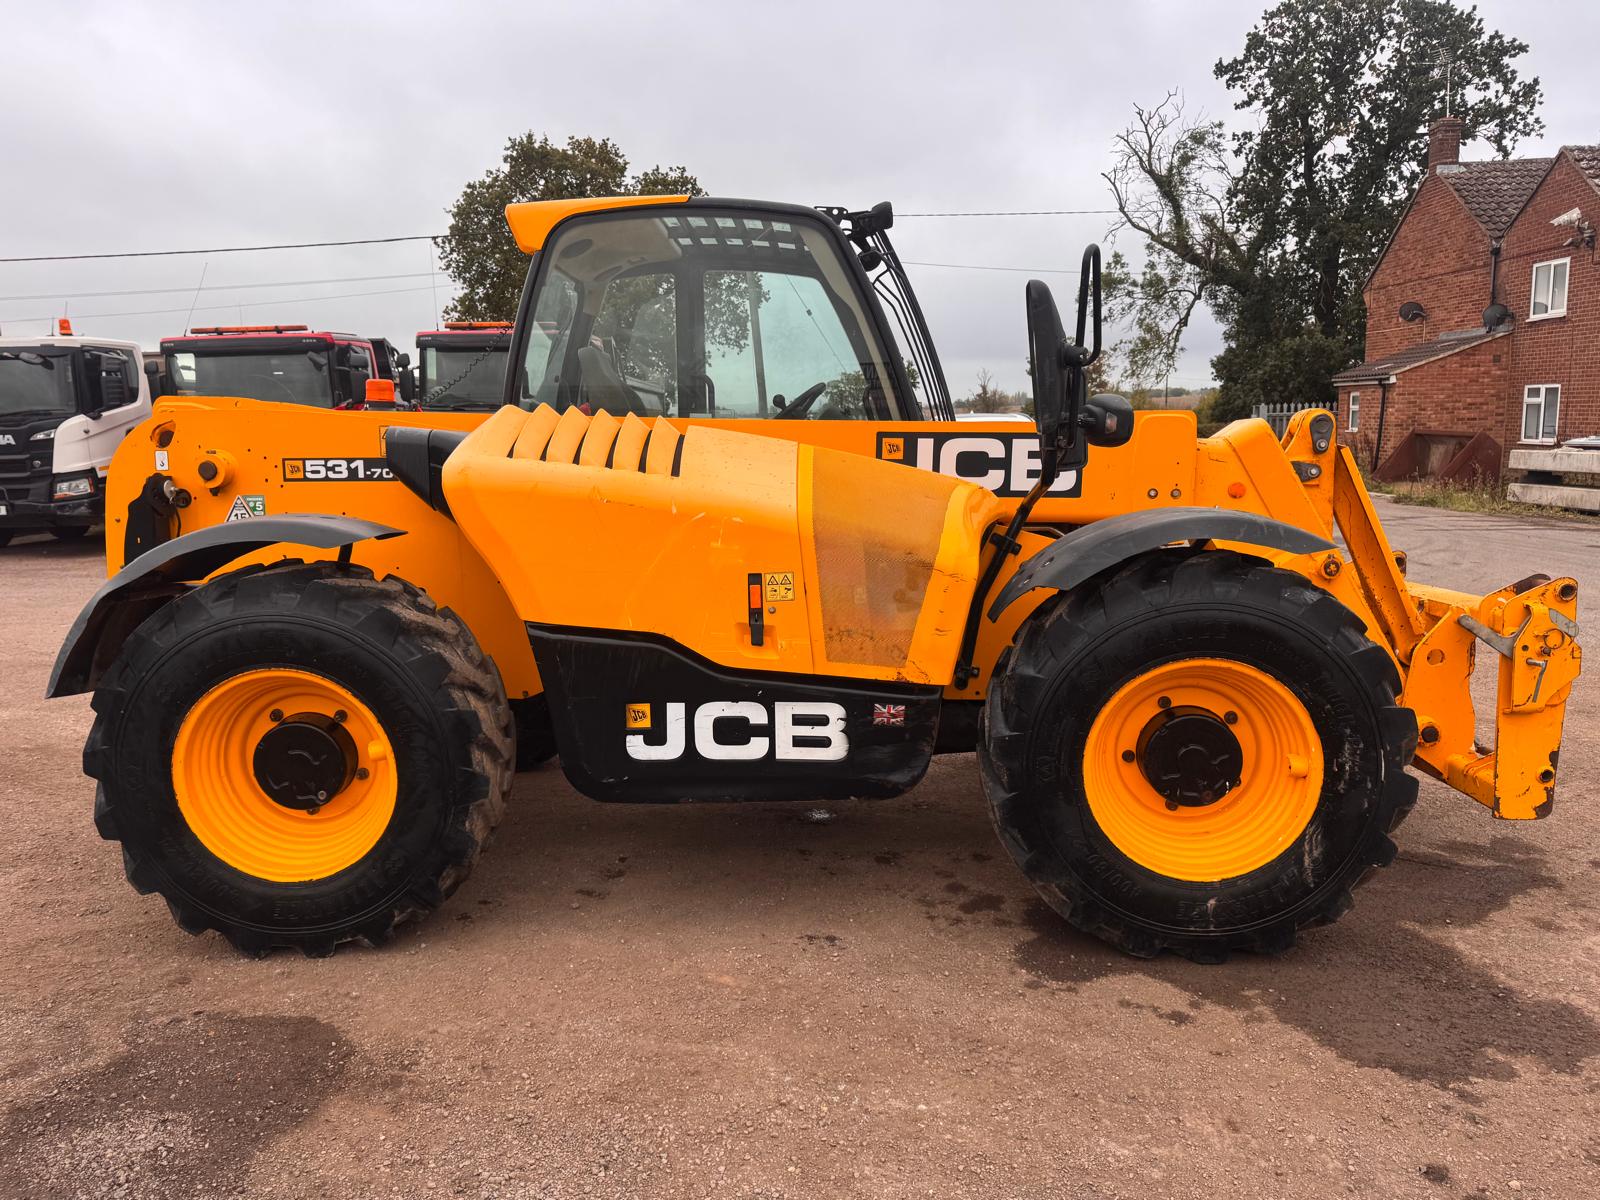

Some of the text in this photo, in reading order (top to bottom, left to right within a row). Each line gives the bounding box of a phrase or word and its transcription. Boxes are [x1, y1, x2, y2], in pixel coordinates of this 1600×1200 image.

[305, 460, 394, 479] 531-70
[255, 501, 263, 511] 5
[625, 701, 848, 761] JCB
